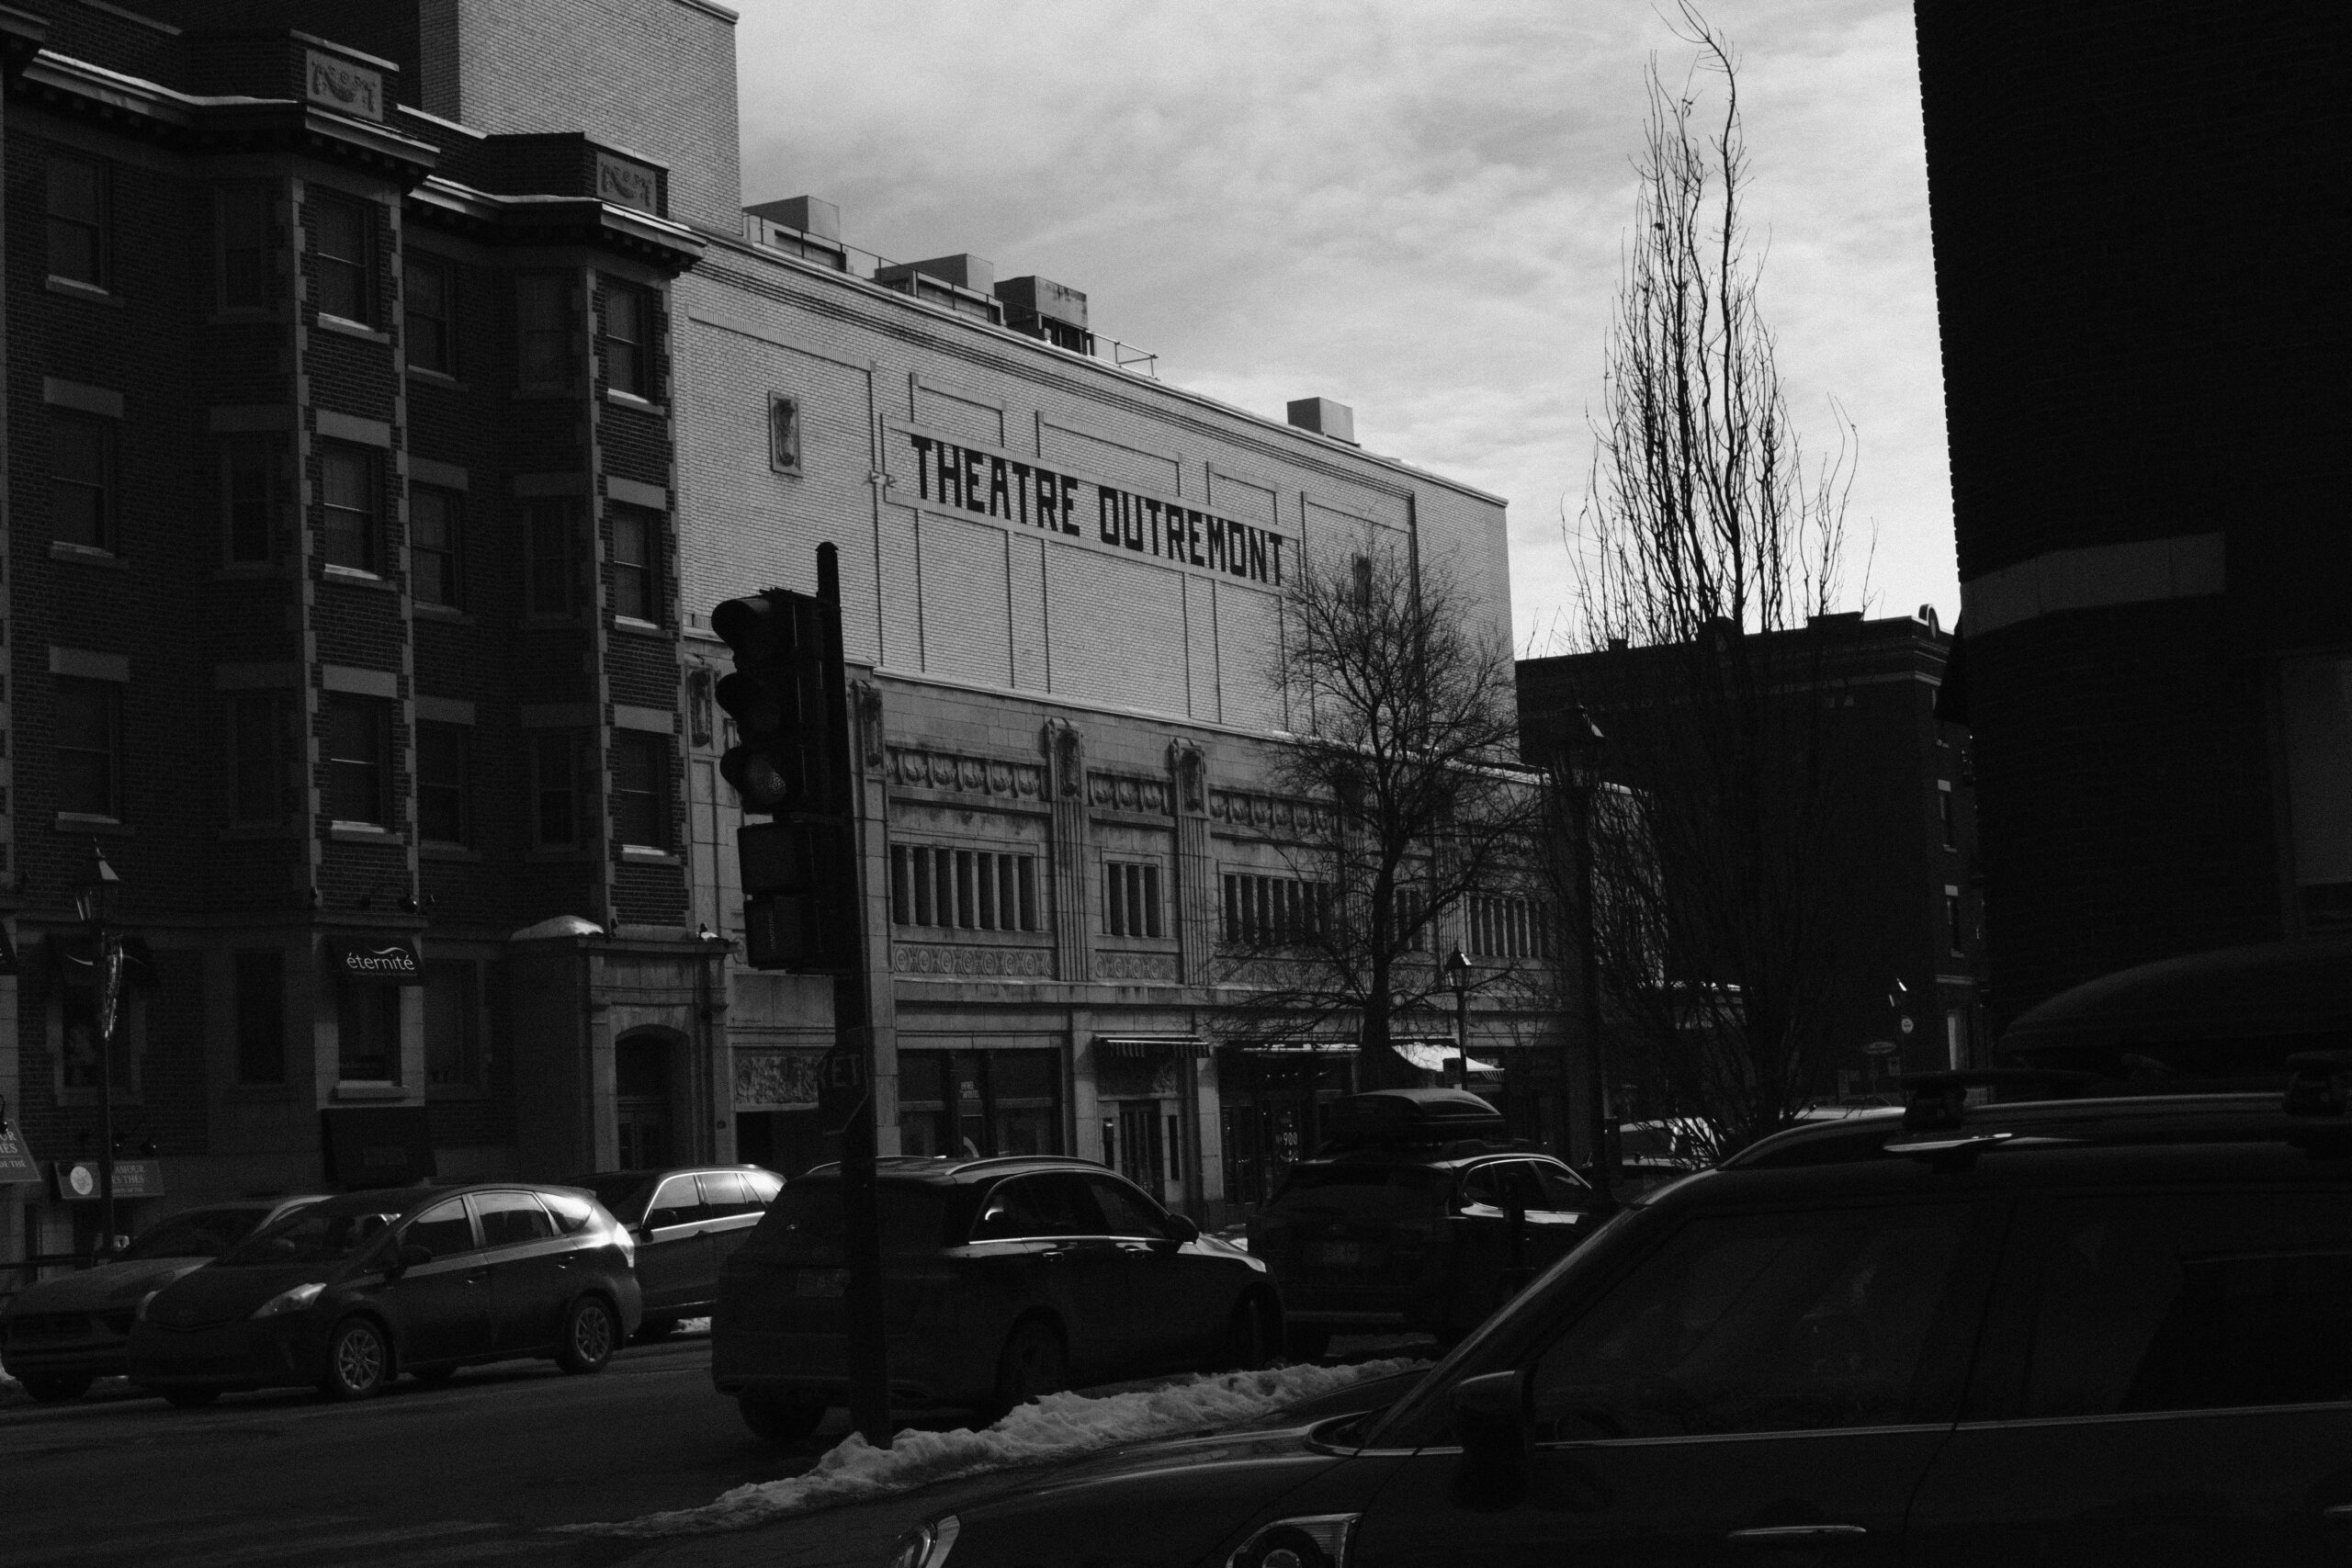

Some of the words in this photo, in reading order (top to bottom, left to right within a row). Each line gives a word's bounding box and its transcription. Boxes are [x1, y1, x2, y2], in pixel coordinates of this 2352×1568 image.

[911, 434, 1080, 536] THEATRE
[1098, 485, 1283, 587] OUTREMONT
[346, 952, 415, 970] éternité
[1283, 1132, 1298, 1146] 900
